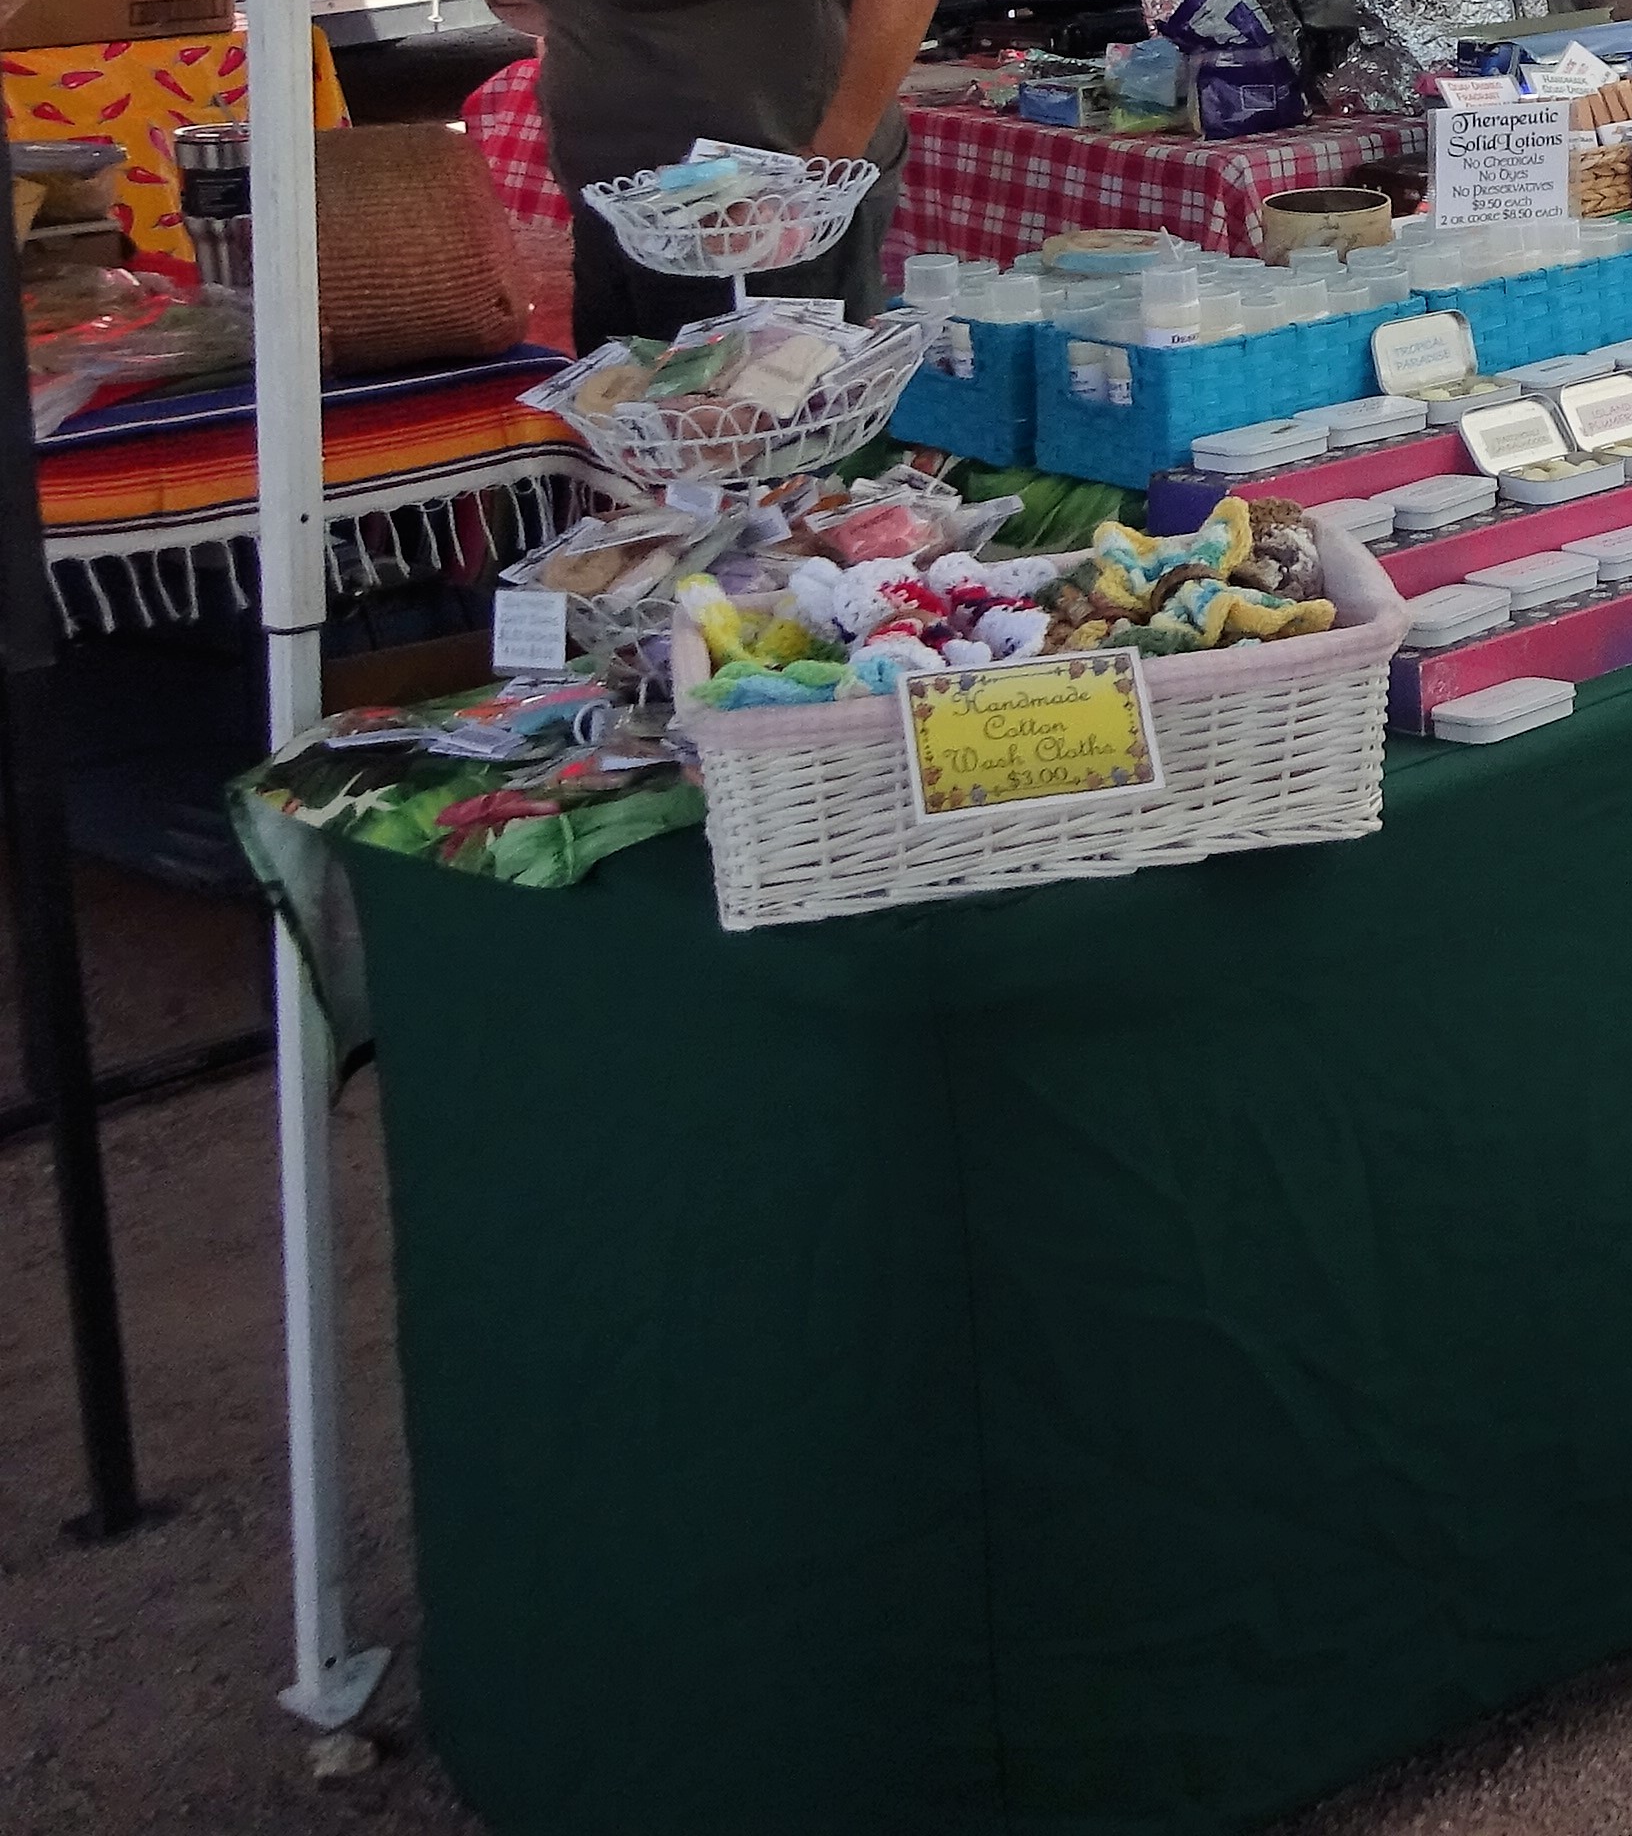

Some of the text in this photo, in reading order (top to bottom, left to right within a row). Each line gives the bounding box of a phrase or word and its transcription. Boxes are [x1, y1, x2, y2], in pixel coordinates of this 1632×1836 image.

[1451, 107, 1559, 134] Therapeutic
[1447, 131, 1563, 157] Solid Lotions
[1463, 153, 1545, 170] No Chemicals
[1479, 170, 1496, 182] No
[1452, 185, 1470, 198] No
[1472, 196, 1532, 211] $9.50 each
[1441, 215, 1448, 226] 2
[1450, 216, 1465, 225] or
[1502, 208, 1532, 220] $8.50
[1535, 206, 1563, 218] each
[951, 684, 1092, 718] Handmade
[983, 714, 1068, 741] Cotton
[942, 735, 1117, 773] Wash Cloths
